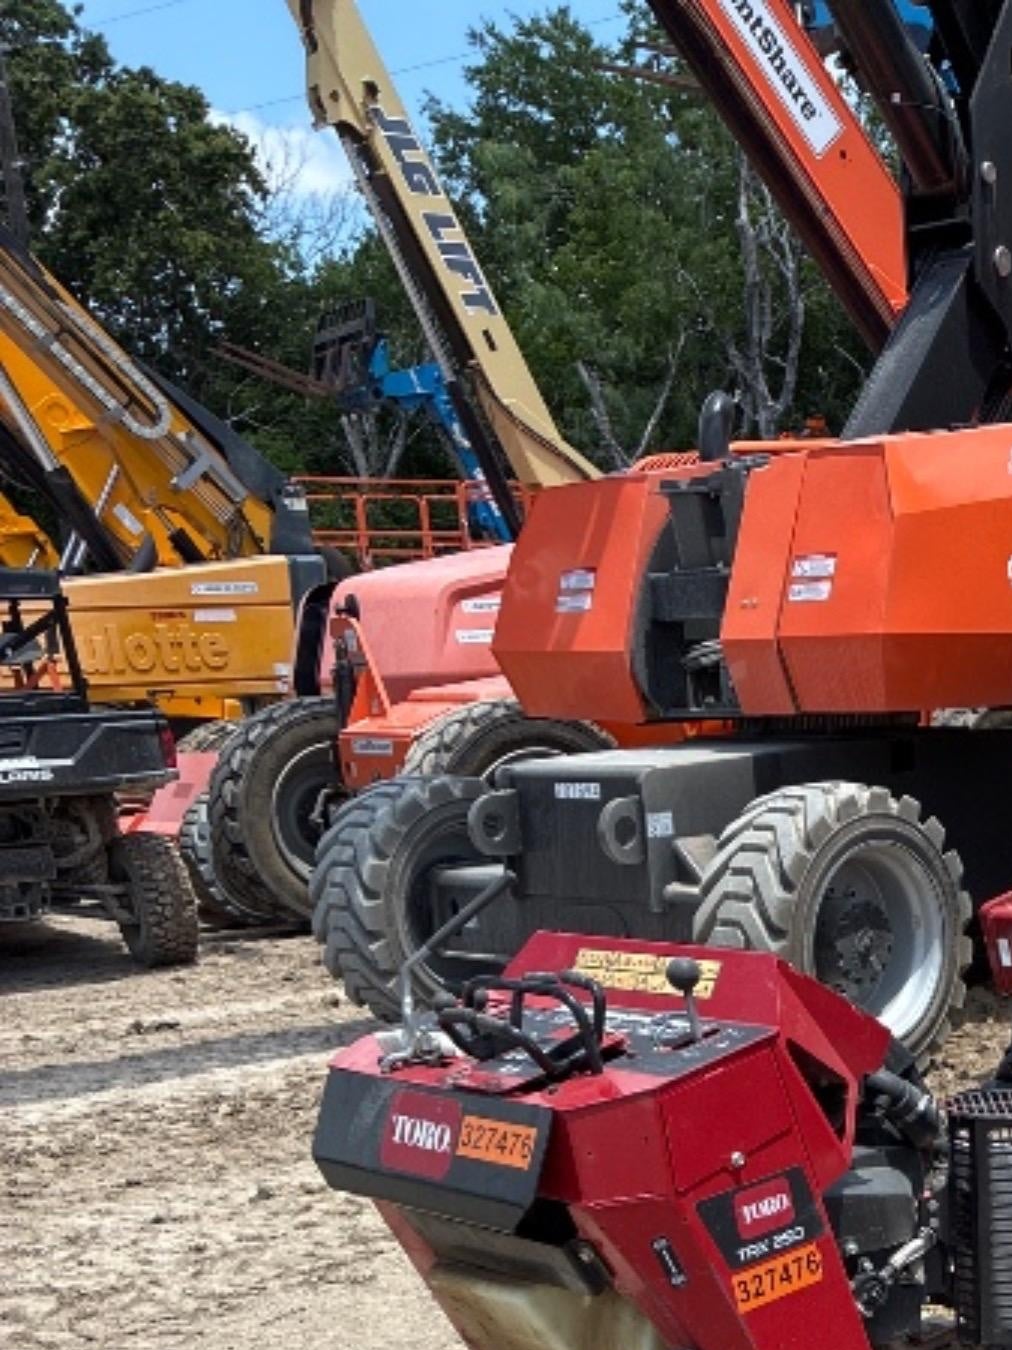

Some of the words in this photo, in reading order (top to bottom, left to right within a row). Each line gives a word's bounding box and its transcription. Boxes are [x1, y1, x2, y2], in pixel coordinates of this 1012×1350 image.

[733, 0, 817, 121] ntShare
[367, 105, 443, 196] JLG
[420, 212, 499, 316] LIFT
[392, 1114, 451, 1153] TORO
[460, 1121, 532, 1160] 327476
[742, 1192, 792, 1225] TORO
[736, 1250, 821, 1303] 327476
